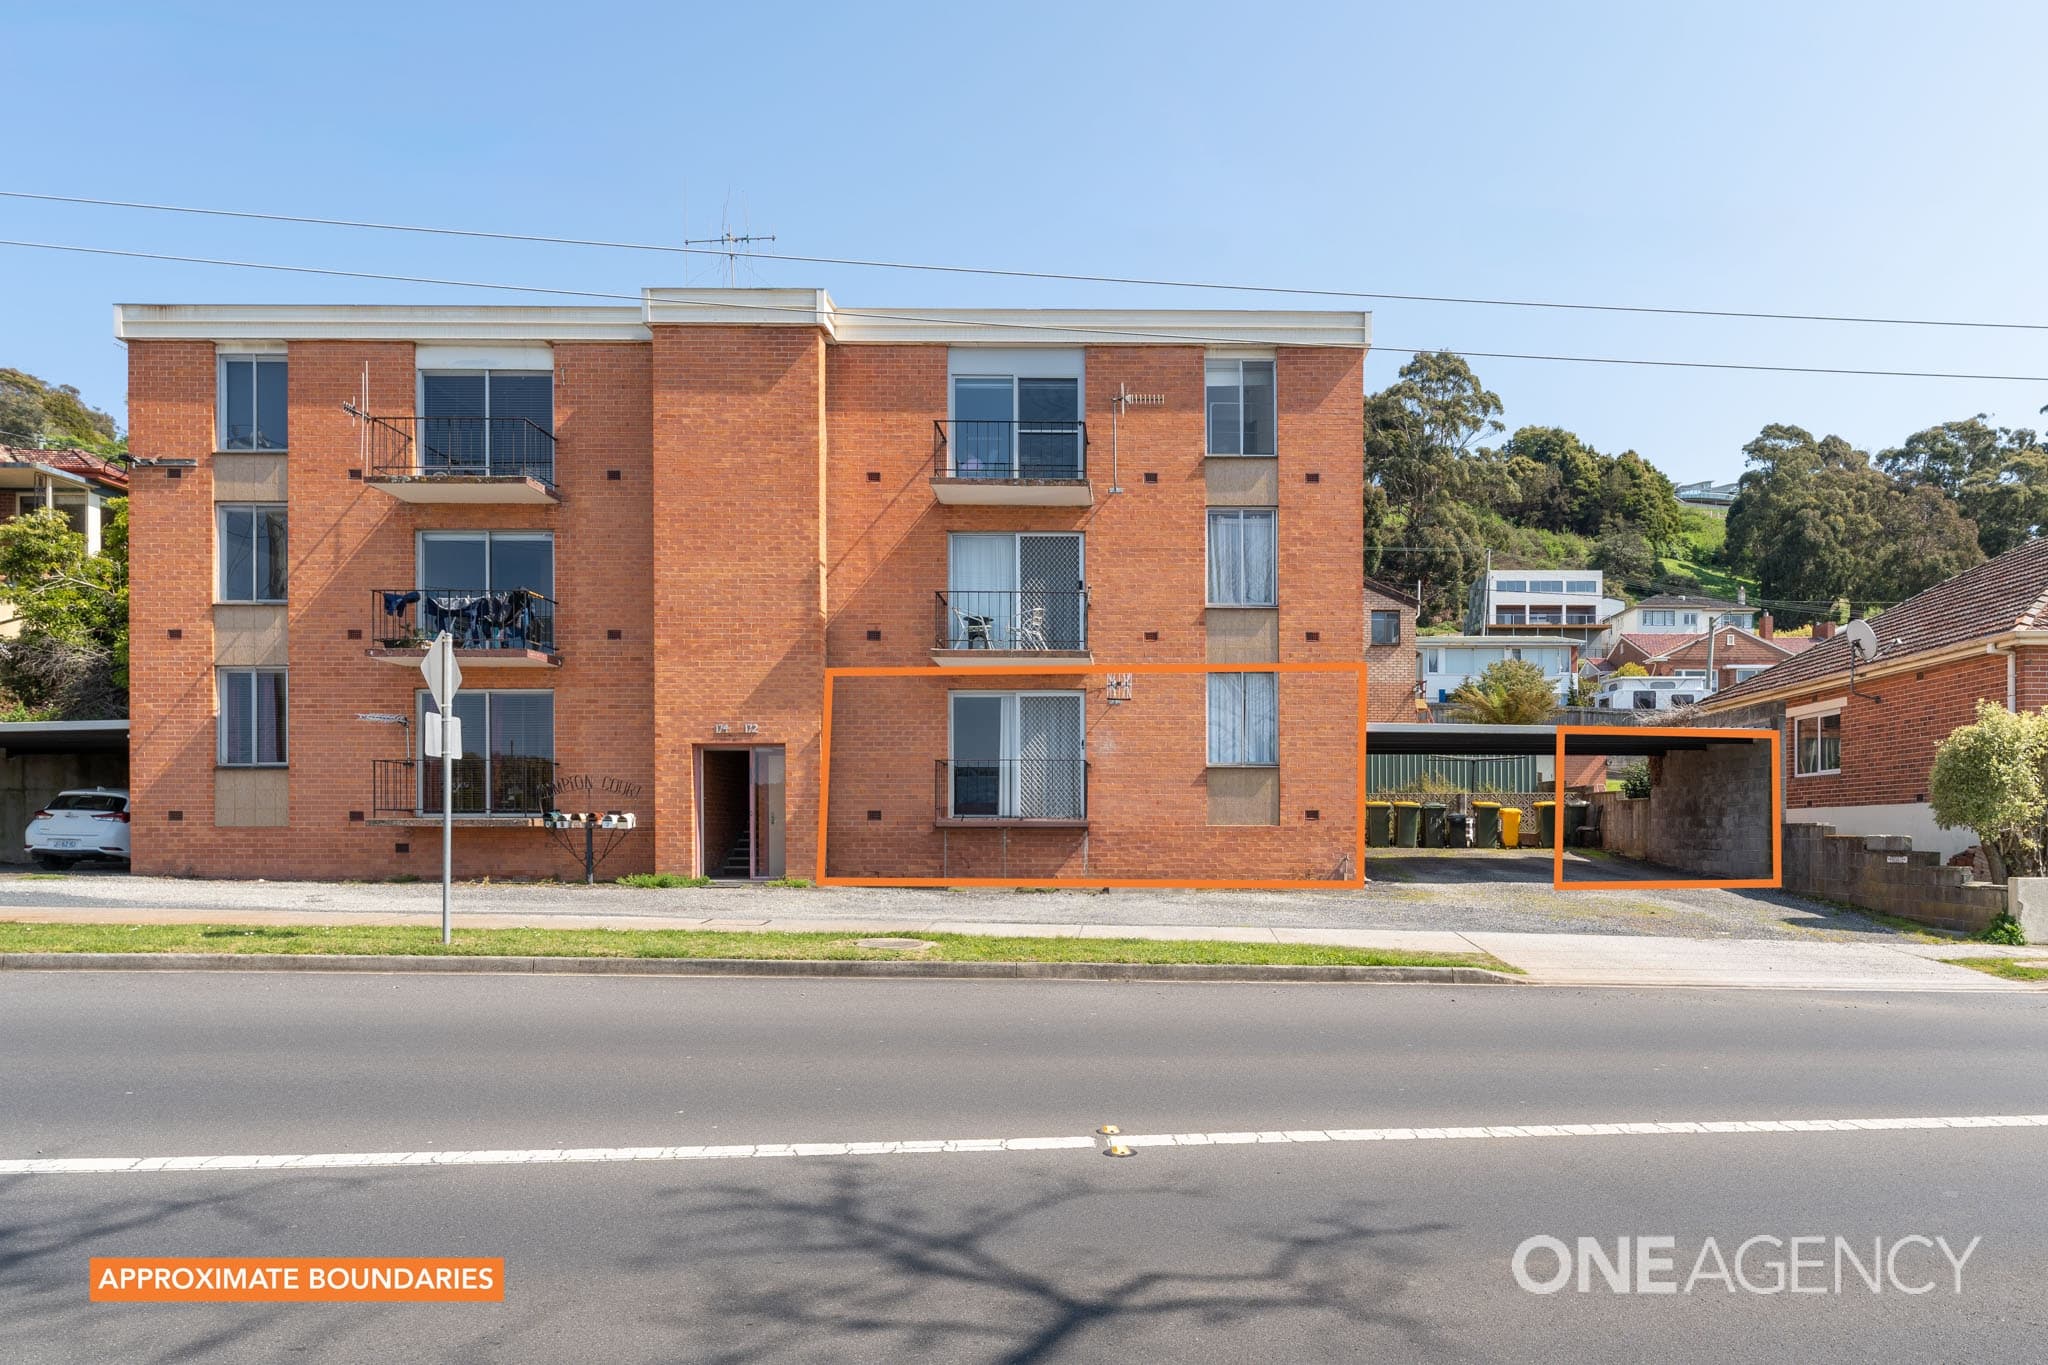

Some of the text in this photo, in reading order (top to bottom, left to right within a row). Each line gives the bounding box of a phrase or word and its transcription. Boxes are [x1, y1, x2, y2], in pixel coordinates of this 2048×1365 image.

[744, 723, 759, 734] 172
[537, 774, 642, 800] MPTON COURT
